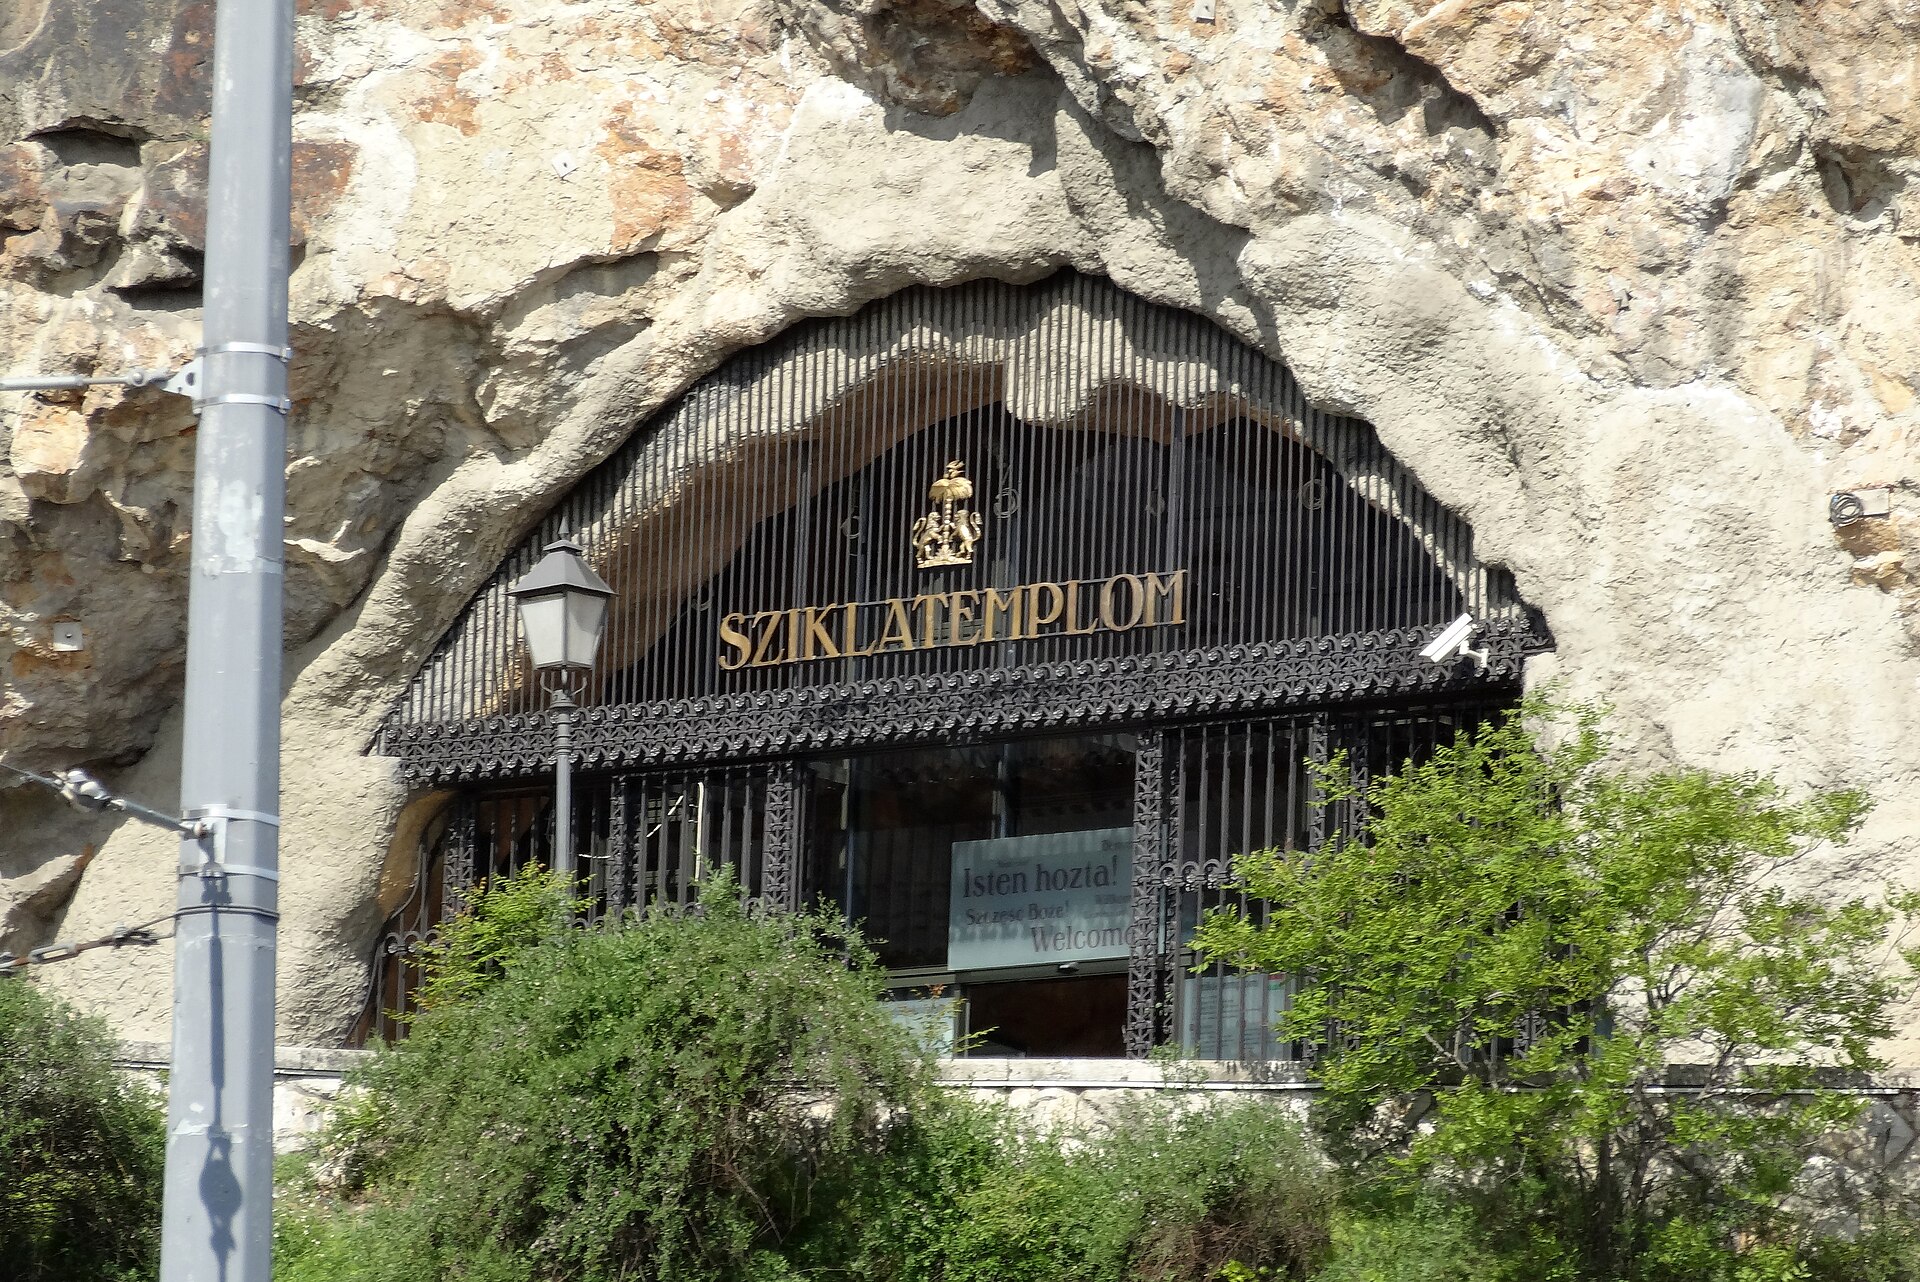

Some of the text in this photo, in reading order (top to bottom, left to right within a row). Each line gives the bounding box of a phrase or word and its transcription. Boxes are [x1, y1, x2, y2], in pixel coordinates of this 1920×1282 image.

[718, 569, 1187, 671] SZIKLATEMPLOM
[962, 854, 1118, 898] Isten hozta!
